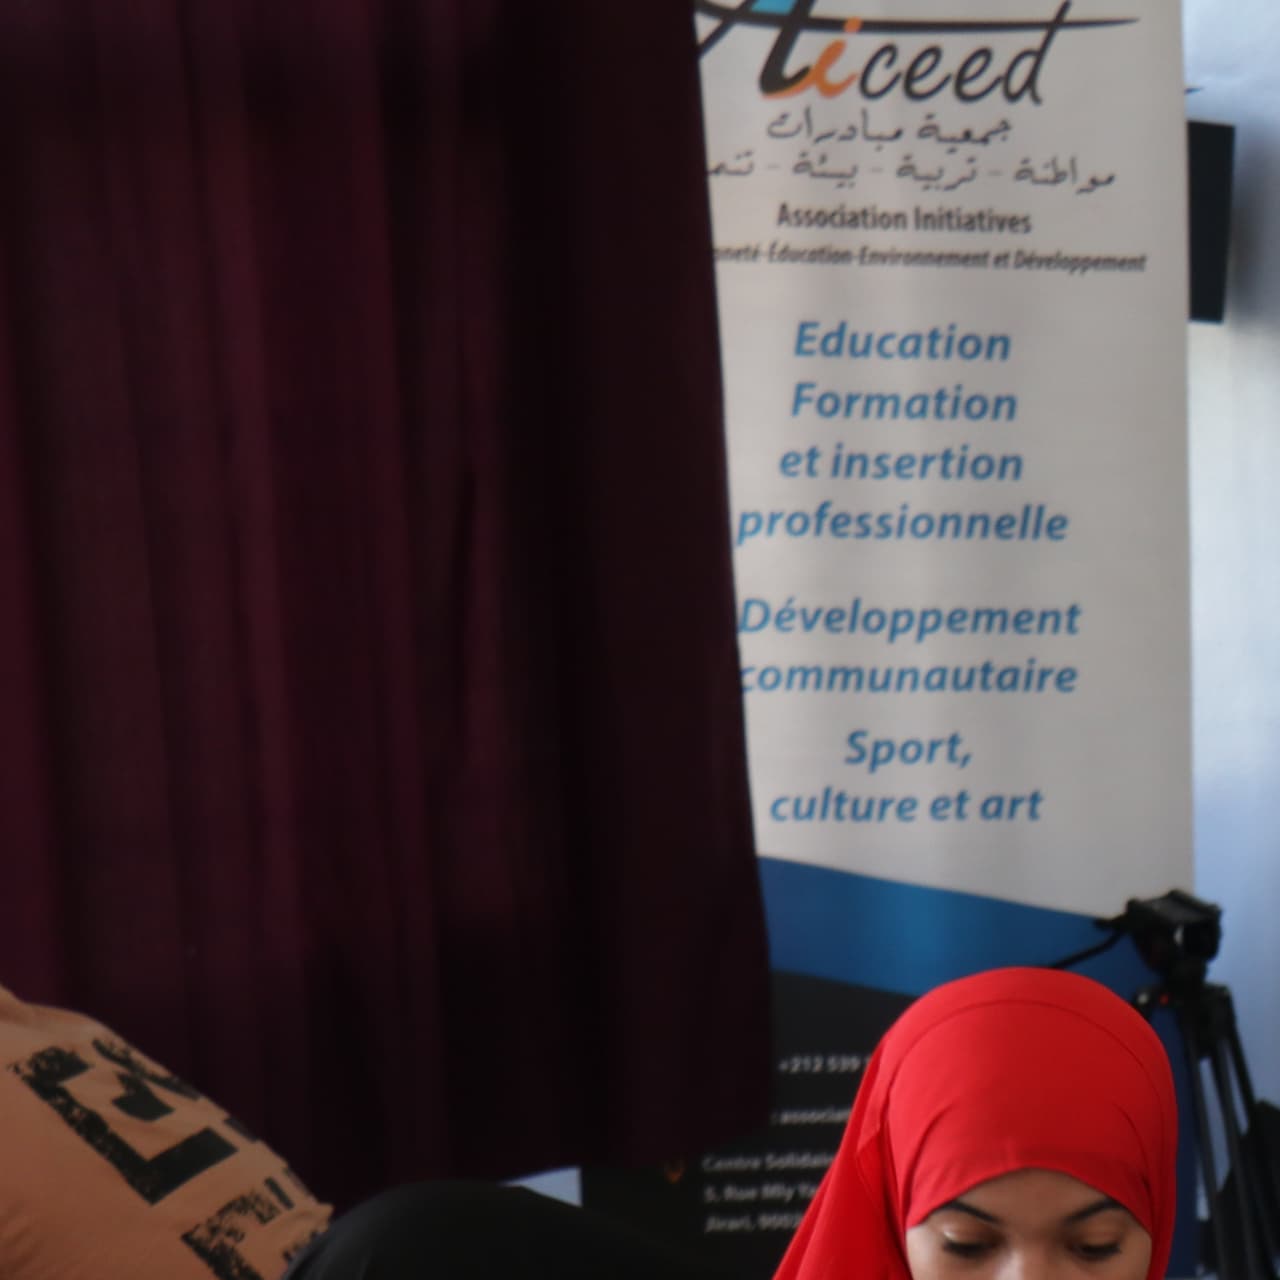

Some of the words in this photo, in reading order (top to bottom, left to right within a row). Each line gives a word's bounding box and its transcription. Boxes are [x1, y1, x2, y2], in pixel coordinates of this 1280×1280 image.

[916, 112, 1013, 155] جمعية
[777, 203, 907, 233] Association
[914, 205, 1033, 235] Initiatives
[1013, 250, 1148, 276] Développement
[793, 321, 1012, 361] Education
[790, 382, 1018, 422] Formation
[778, 445, 820, 479] et
[830, 443, 1025, 481] insertion
[735, 500, 1071, 547] professionnelle
[736, 597, 1083, 643] Développement
[844, 730, 974, 774] Sport,
[769, 787, 918, 823] culture
[929, 790, 969, 822] et
[979, 789, 1045, 823] art
